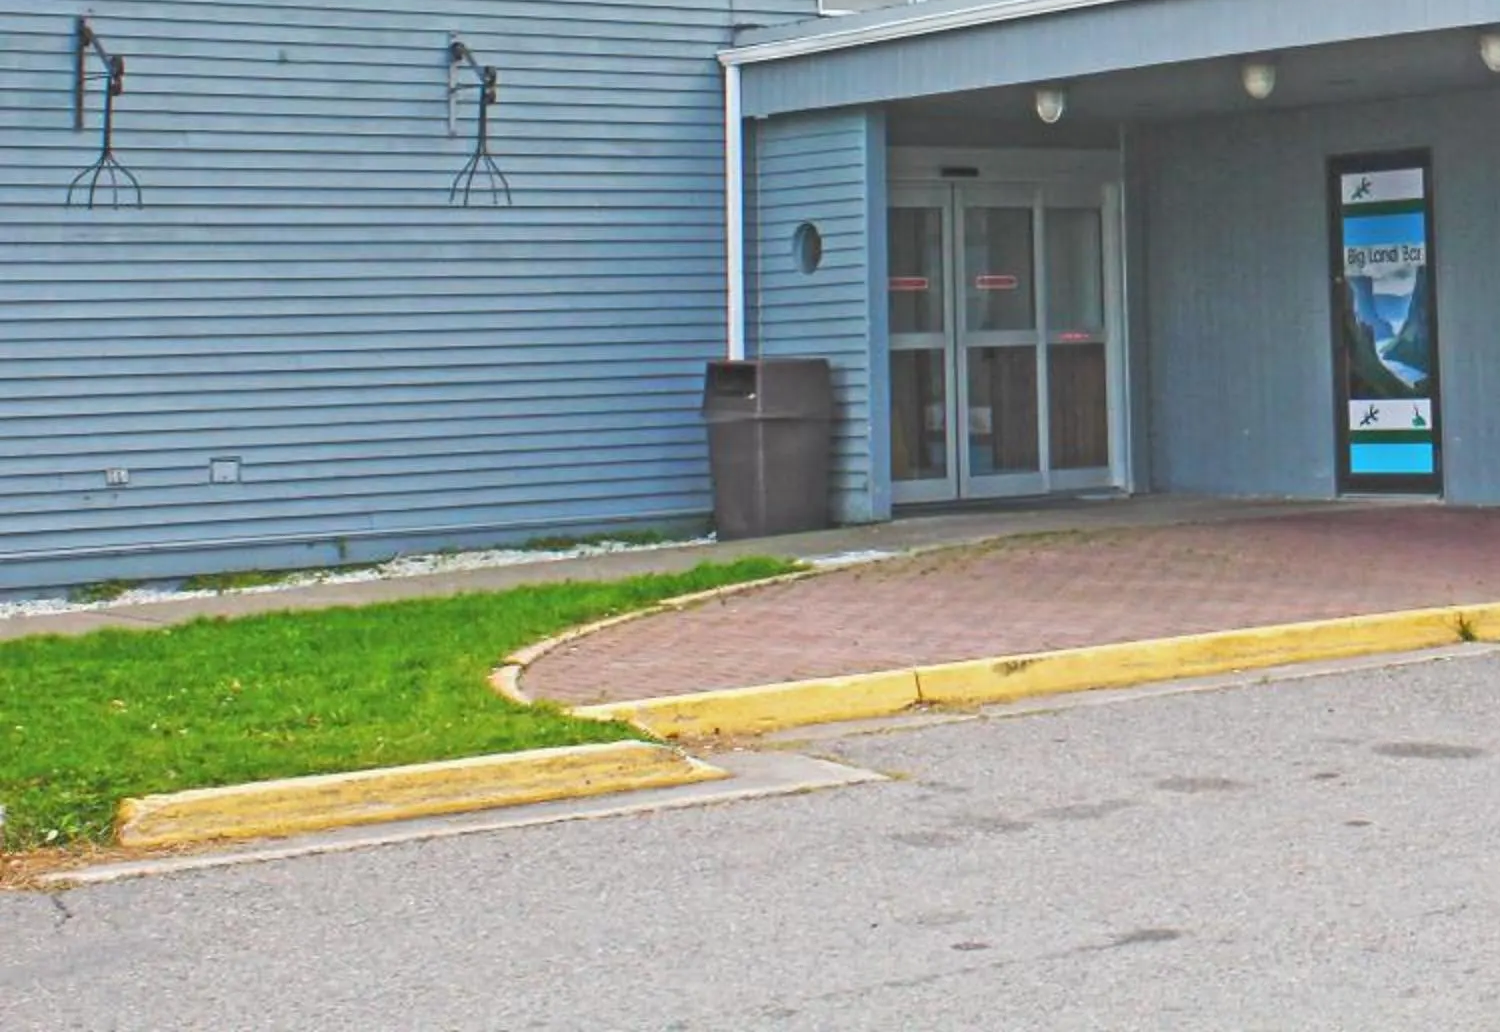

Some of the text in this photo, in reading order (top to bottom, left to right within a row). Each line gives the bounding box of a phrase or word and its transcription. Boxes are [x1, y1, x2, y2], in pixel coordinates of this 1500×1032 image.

[1347, 245, 1422, 268] Big Land Bar
